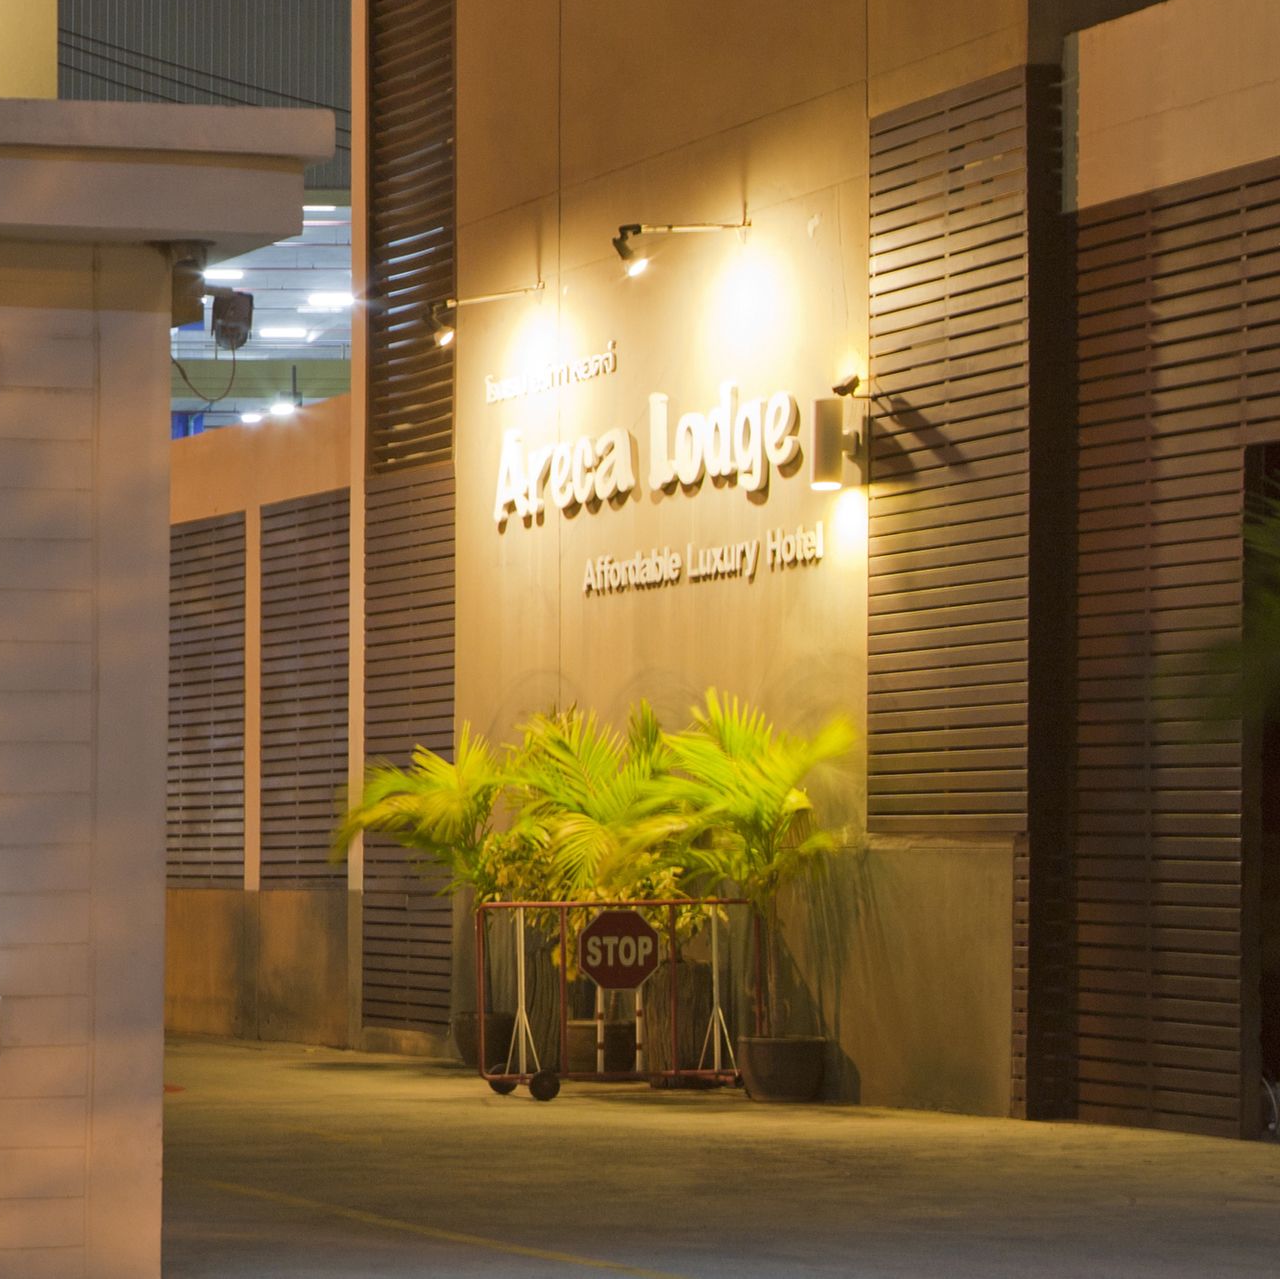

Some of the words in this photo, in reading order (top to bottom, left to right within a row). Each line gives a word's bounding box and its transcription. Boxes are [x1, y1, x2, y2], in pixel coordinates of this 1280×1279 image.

[494, 427, 636, 524] Areca
[648, 380, 800, 493] Lodge
[583, 547, 681, 593] Affordable
[687, 537, 758, 581] Luxury
[767, 521, 823, 565] Hotel
[587, 935, 653, 967] STOP
